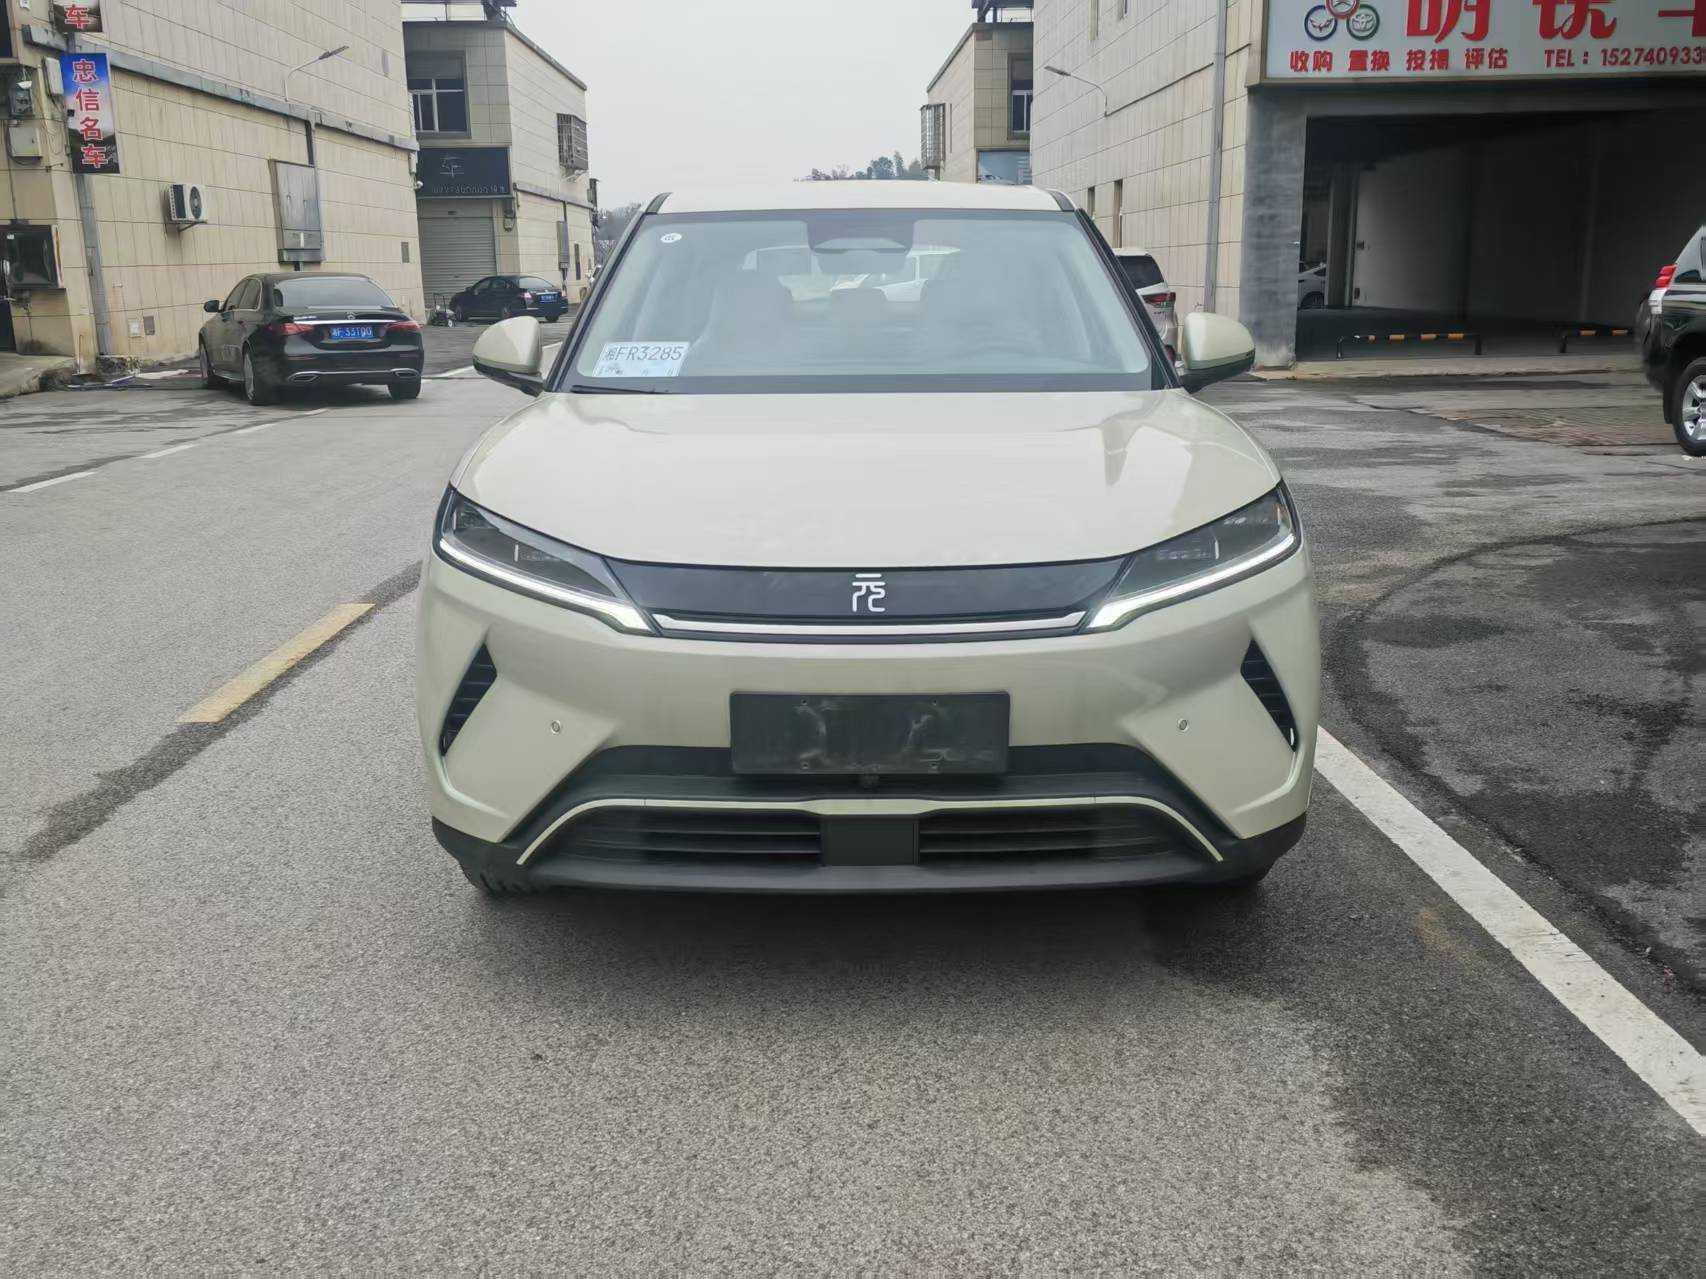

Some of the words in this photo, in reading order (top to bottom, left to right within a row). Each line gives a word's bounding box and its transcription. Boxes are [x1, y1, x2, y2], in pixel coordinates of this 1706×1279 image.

[64, 3, 91, 29] 车
[1290, 50, 1333, 72] 收购
[1347, 49, 1390, 72] 置换
[1464, 48, 1508, 70] 评估
[72, 58, 109, 169] 忠信名车
